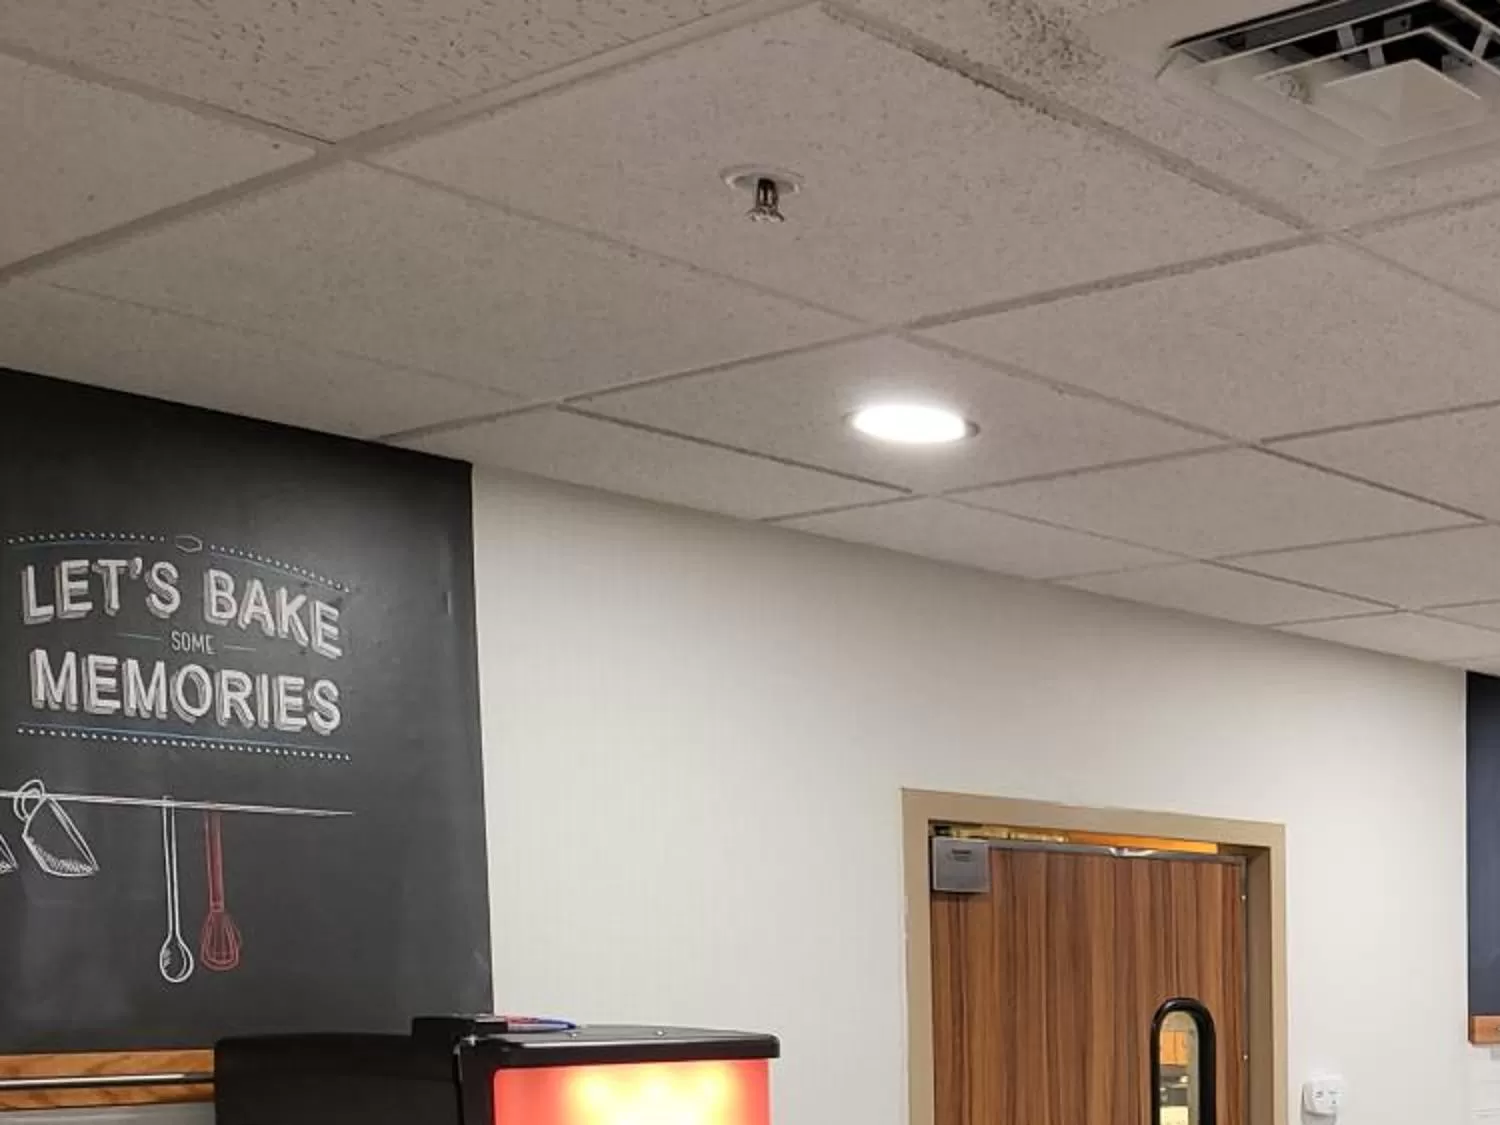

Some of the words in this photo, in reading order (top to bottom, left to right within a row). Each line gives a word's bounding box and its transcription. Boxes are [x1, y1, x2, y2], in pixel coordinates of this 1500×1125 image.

[22, 556, 182, 625] LET'S
[203, 568, 343, 661] BAKE
[171, 631, 217, 655] SOME
[29, 648, 342, 736] MEMORIES
